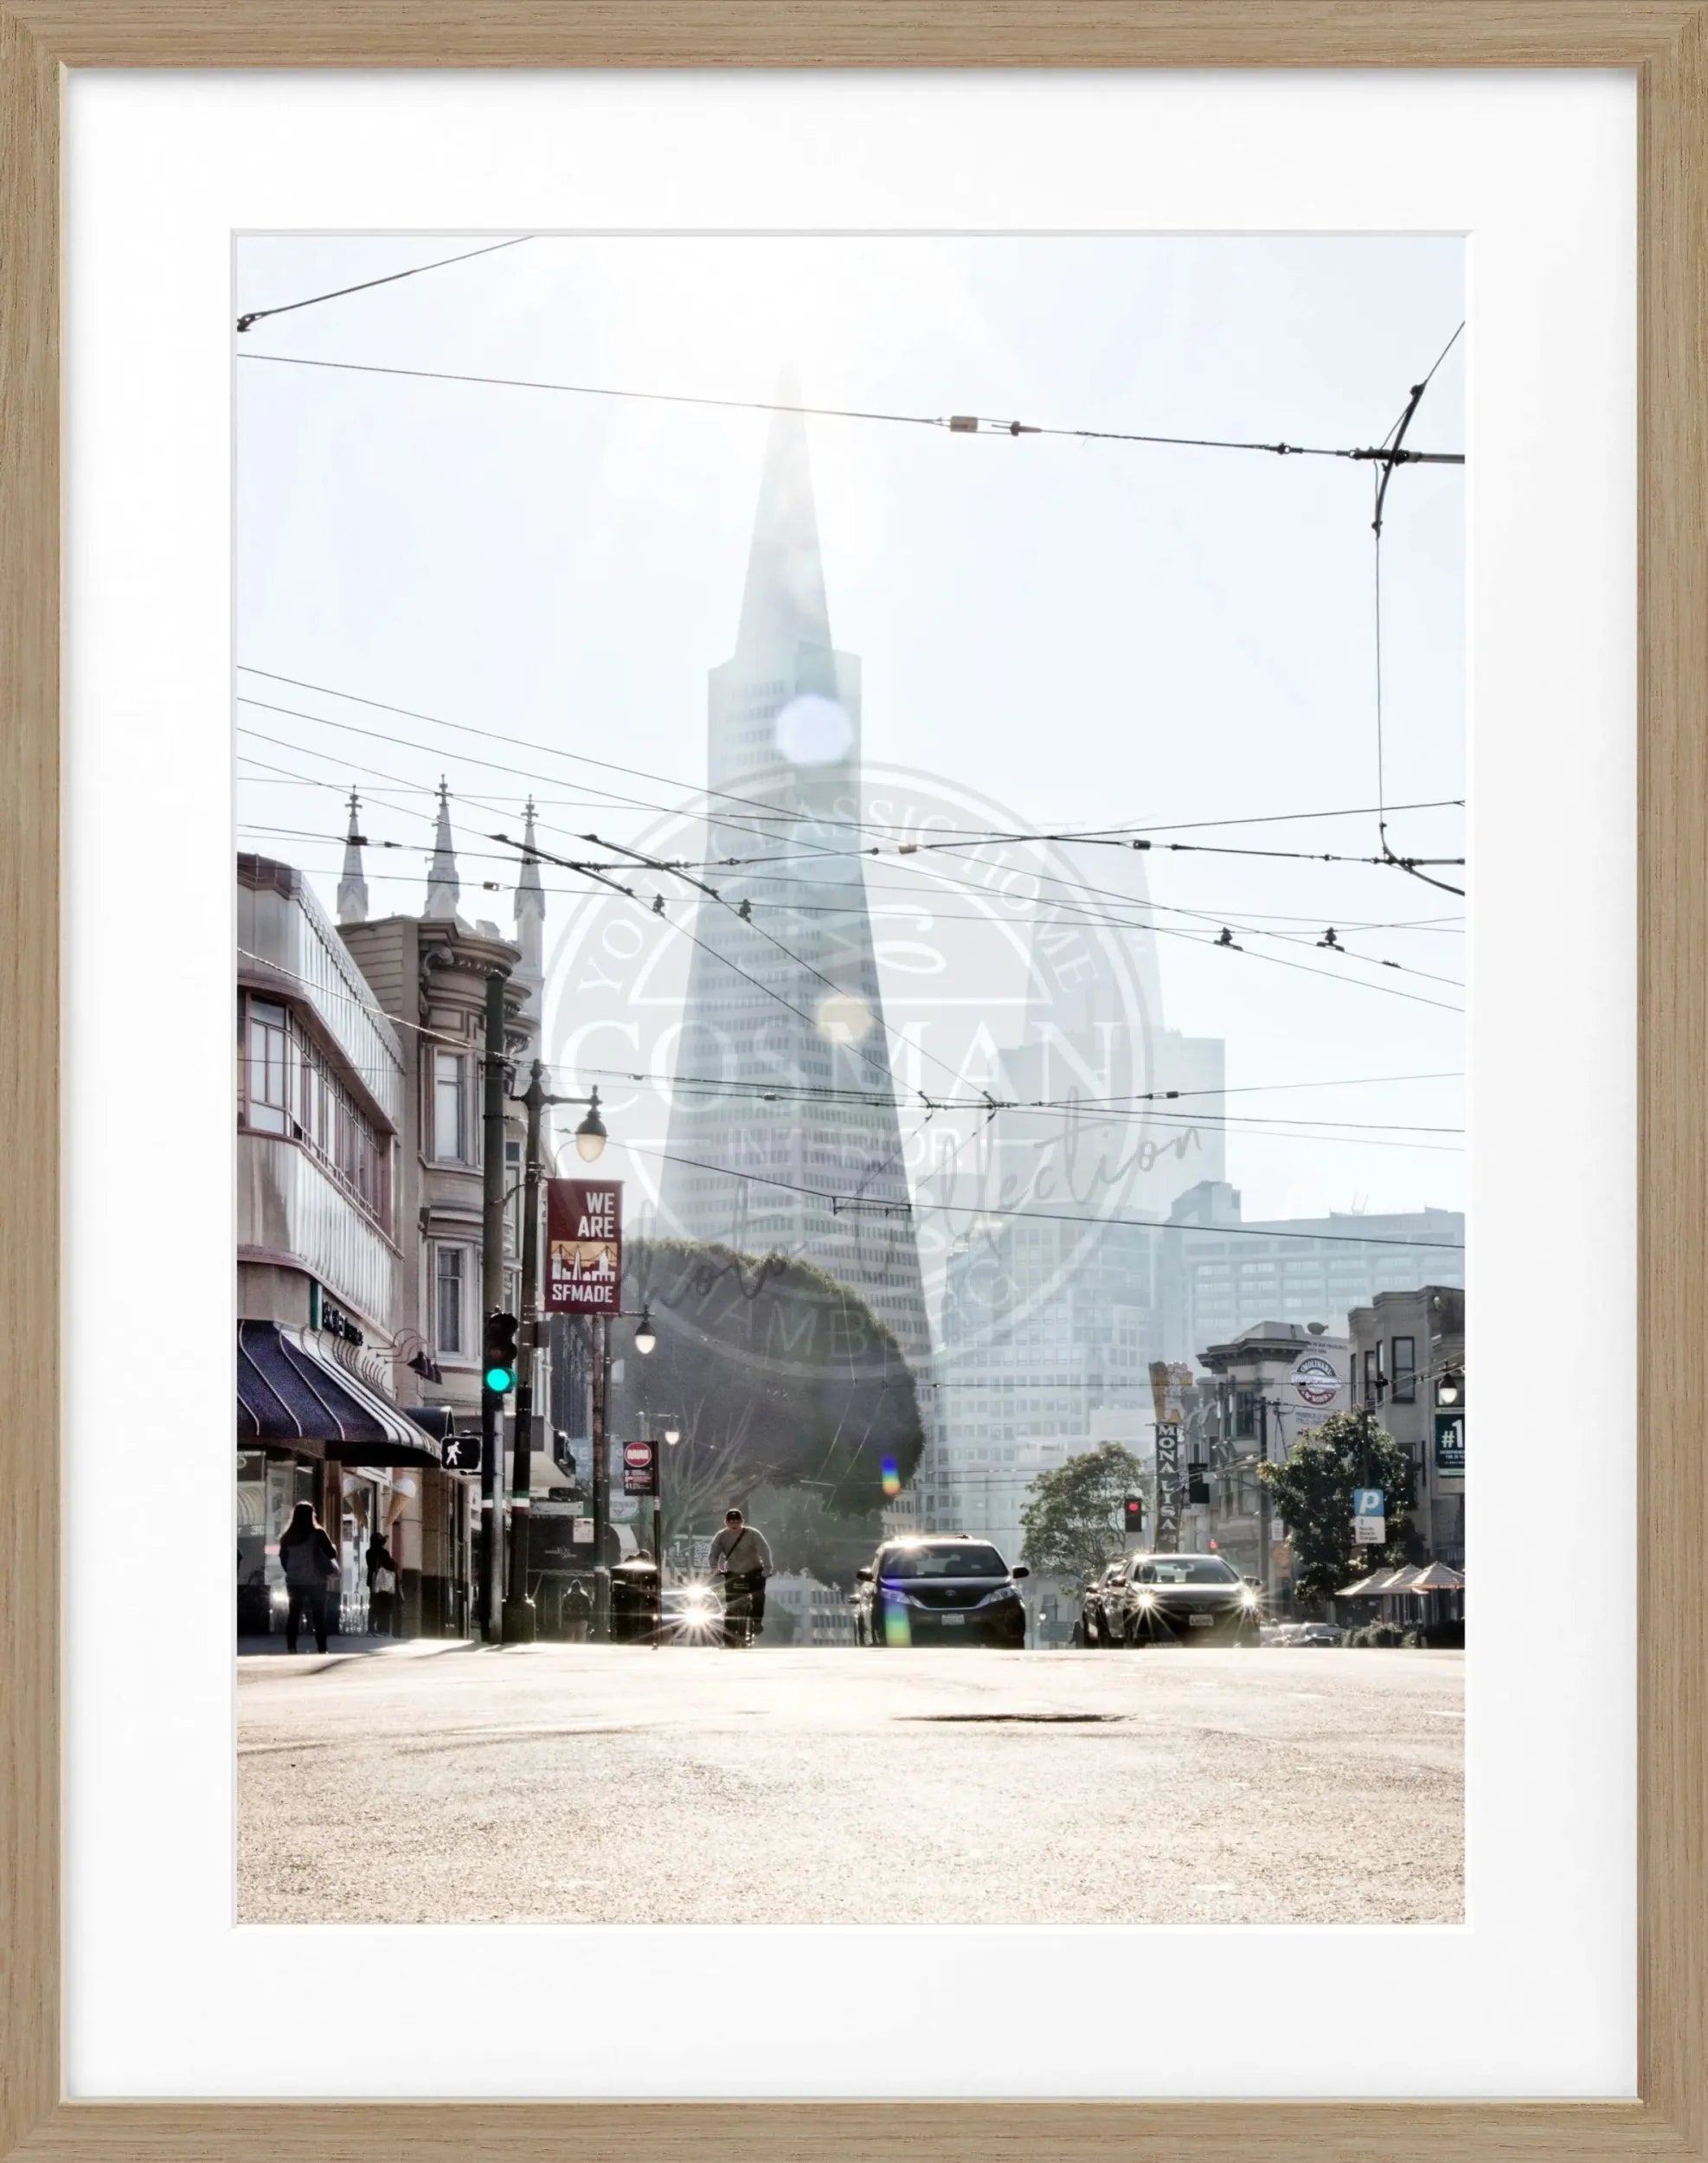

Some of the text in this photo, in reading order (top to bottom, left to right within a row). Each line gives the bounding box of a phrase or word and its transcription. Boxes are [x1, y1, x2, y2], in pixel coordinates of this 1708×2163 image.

[586, 1192, 614, 1214] WE
[577, 1216, 614, 1238] ARE
[552, 1283, 613, 1303] SFMADE
[1441, 1419, 1463, 1448] #1
[1158, 1425, 1176, 1473] MONA
[1160, 1480, 1177, 1530] LISA
[1359, 1492, 1380, 1513] P
